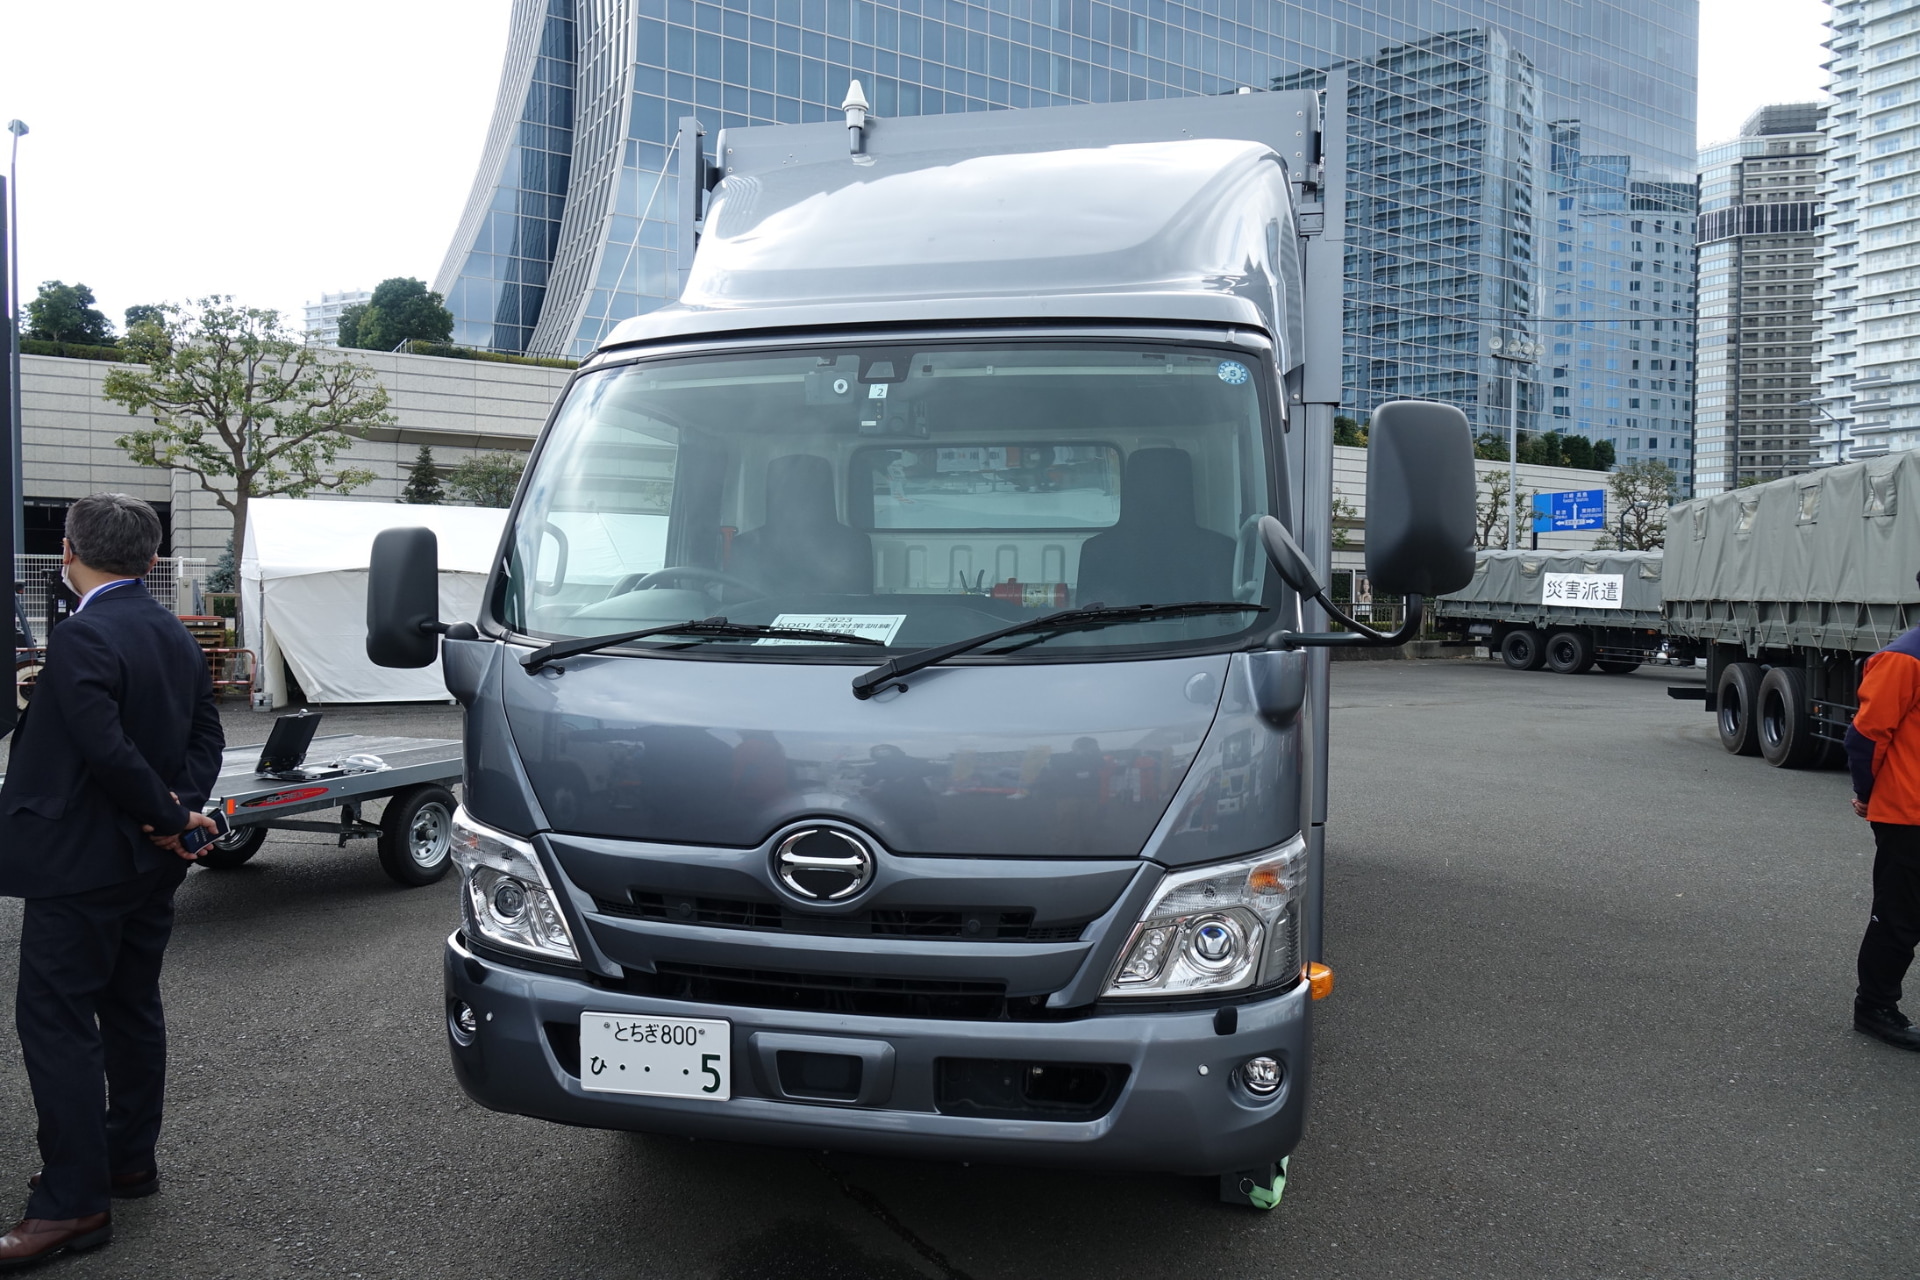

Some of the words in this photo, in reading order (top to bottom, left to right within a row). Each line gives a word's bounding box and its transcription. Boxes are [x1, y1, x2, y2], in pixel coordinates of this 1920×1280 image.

[1546, 580, 1618, 601] 災害派遣
[614, 1022, 697, 1046] とちぎ800
